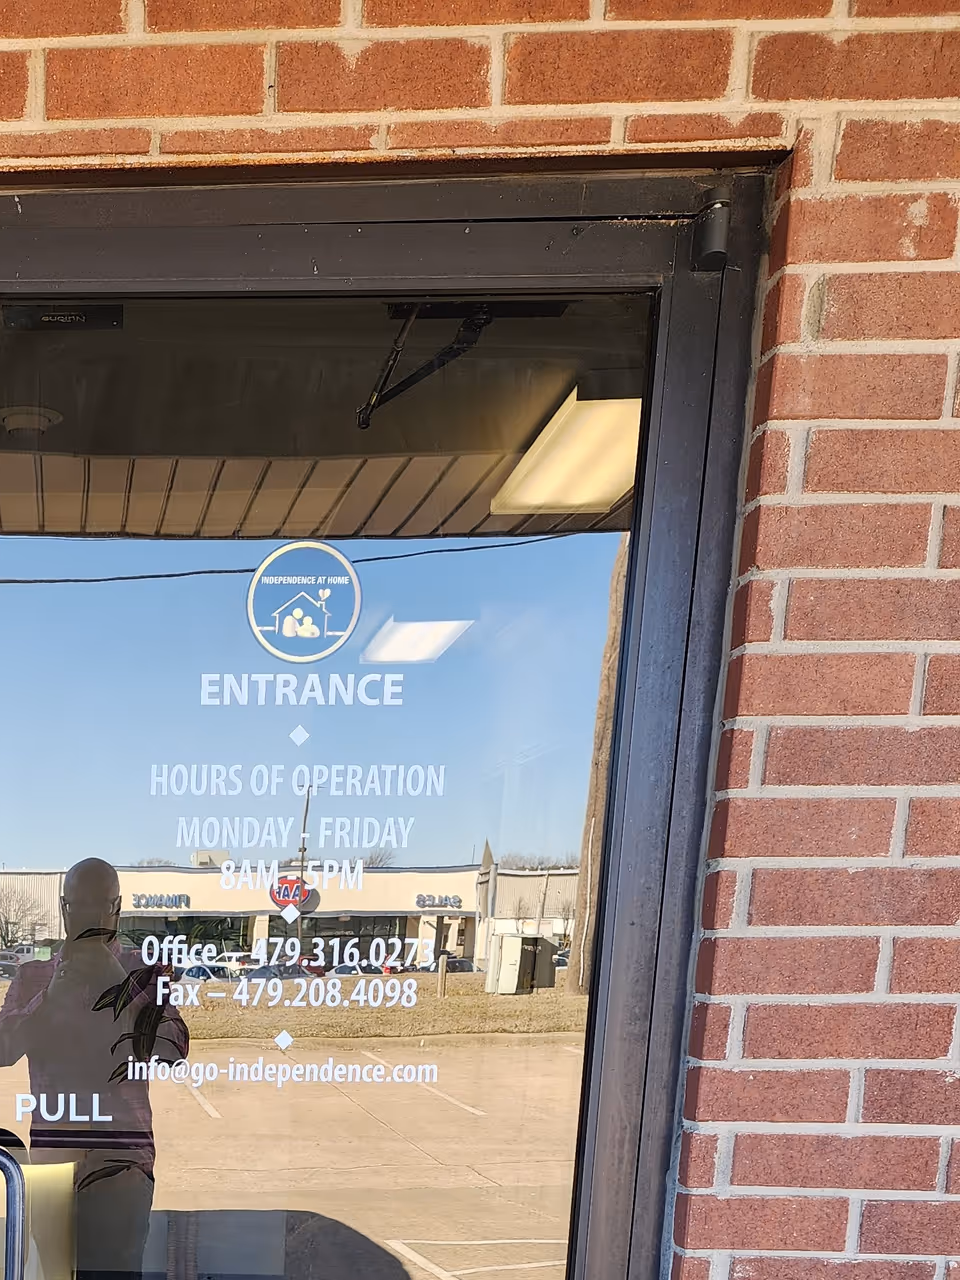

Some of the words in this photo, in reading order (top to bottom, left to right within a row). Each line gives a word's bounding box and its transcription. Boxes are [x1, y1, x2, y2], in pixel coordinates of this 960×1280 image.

[261, 576, 316, 585] INDEPENDENCE
[316, 576, 326, 585] AT
[327, 576, 350, 585] HOME
[200, 673, 404, 706] ENTRANCE
[150, 764, 242, 796] HOURS
[250, 764, 285, 796] OF
[292, 764, 446, 797] OPERATION
[175, 816, 295, 848] MONDAY
[318, 817, 415, 848] FRIDAY
[220, 859, 279, 890] 8AM
[305, 859, 363, 890] 5PM
[141, 935, 217, 966] Office
[251, 937, 436, 968] 479.316.0273
[156, 976, 200, 1006] Fax
[233, 978, 417, 1007] 479.208.4098
[128, 1056, 438, 1087] info@go-independence.com
[15, 1093, 113, 1122] PULL
